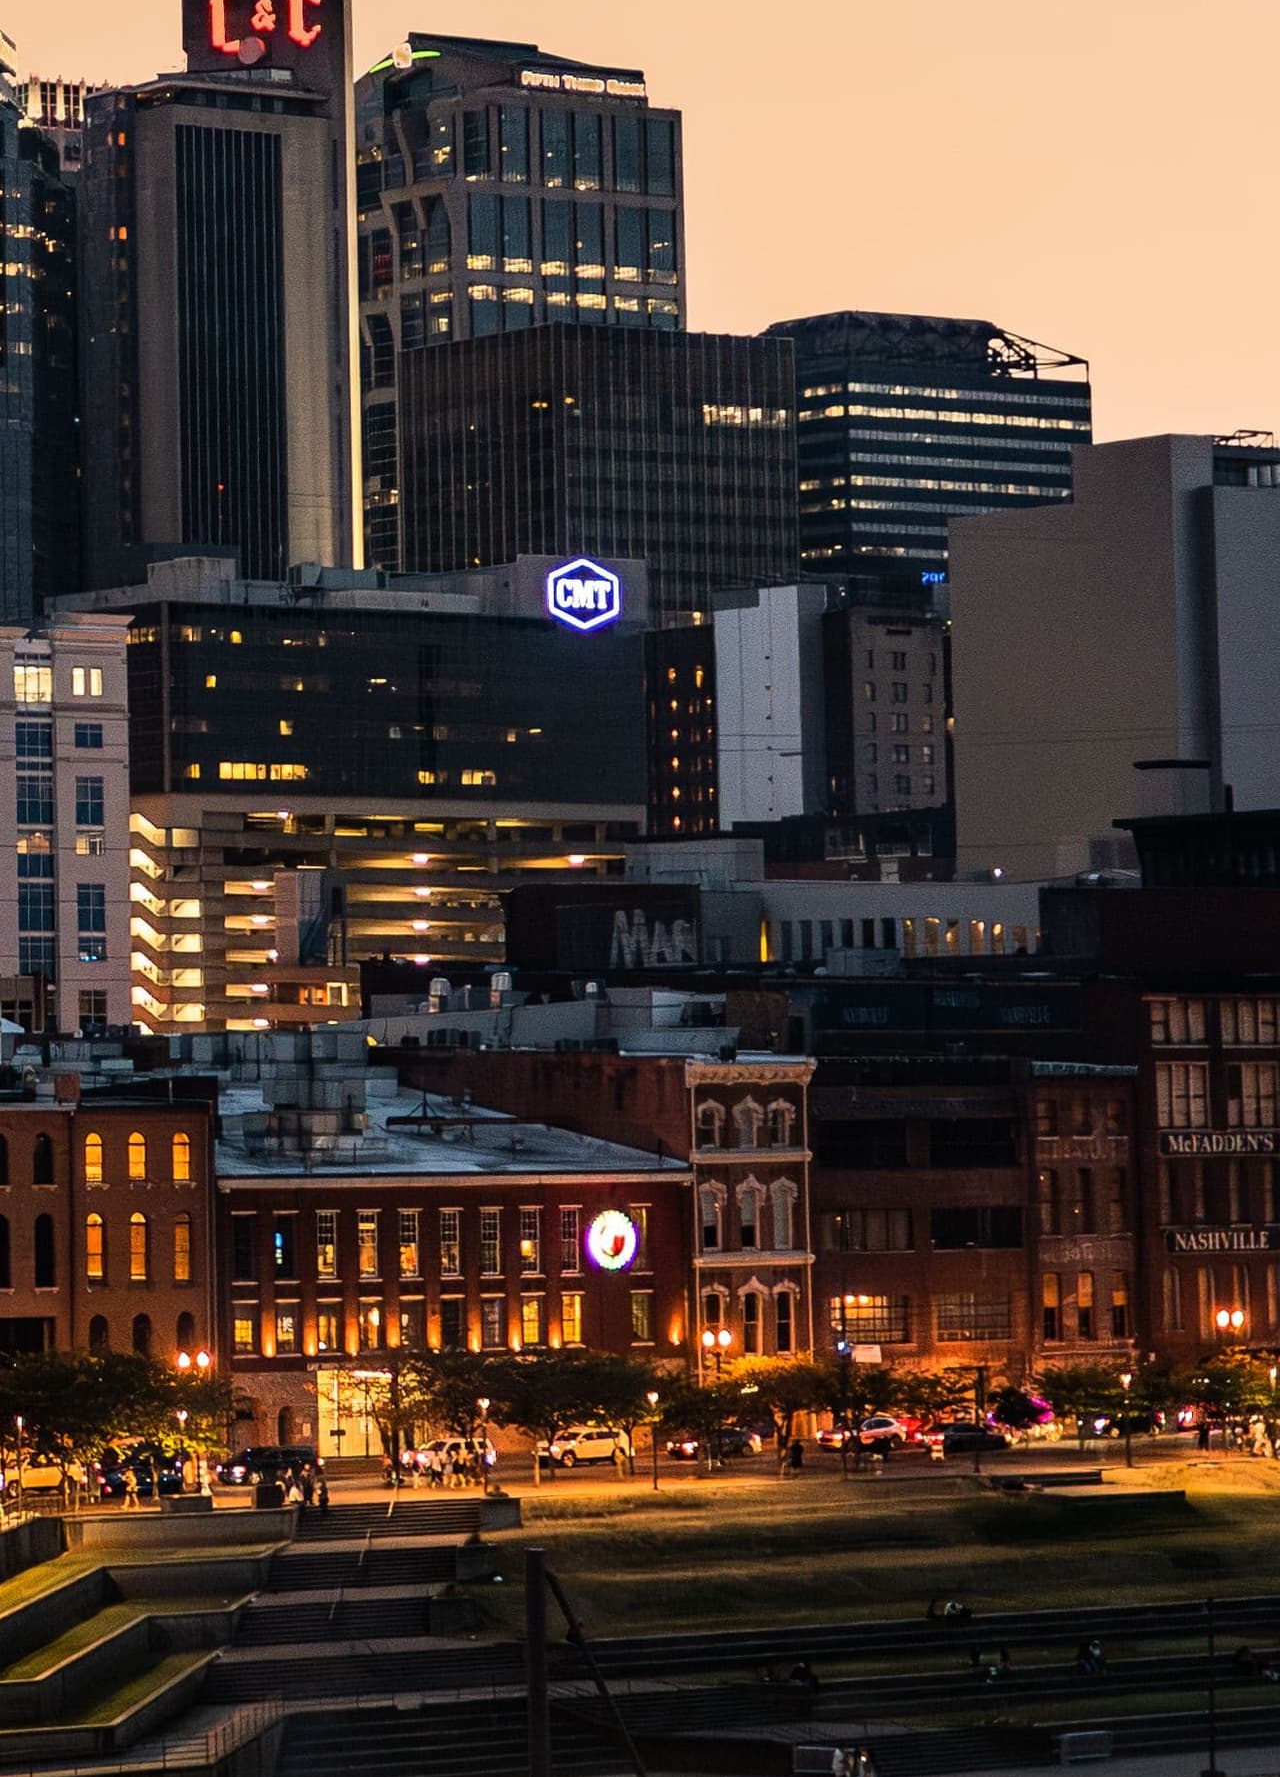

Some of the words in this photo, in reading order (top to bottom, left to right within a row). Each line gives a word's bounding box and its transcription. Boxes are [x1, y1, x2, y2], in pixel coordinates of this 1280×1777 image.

[521, 71, 560, 87] FIFTH
[561, 74, 605, 93] THIRD
[556, 578, 611, 609] CMT
[1168, 1133, 1275, 1153] McFADDEN'S
[1175, 1230, 1271, 1251] NASHVILLE
